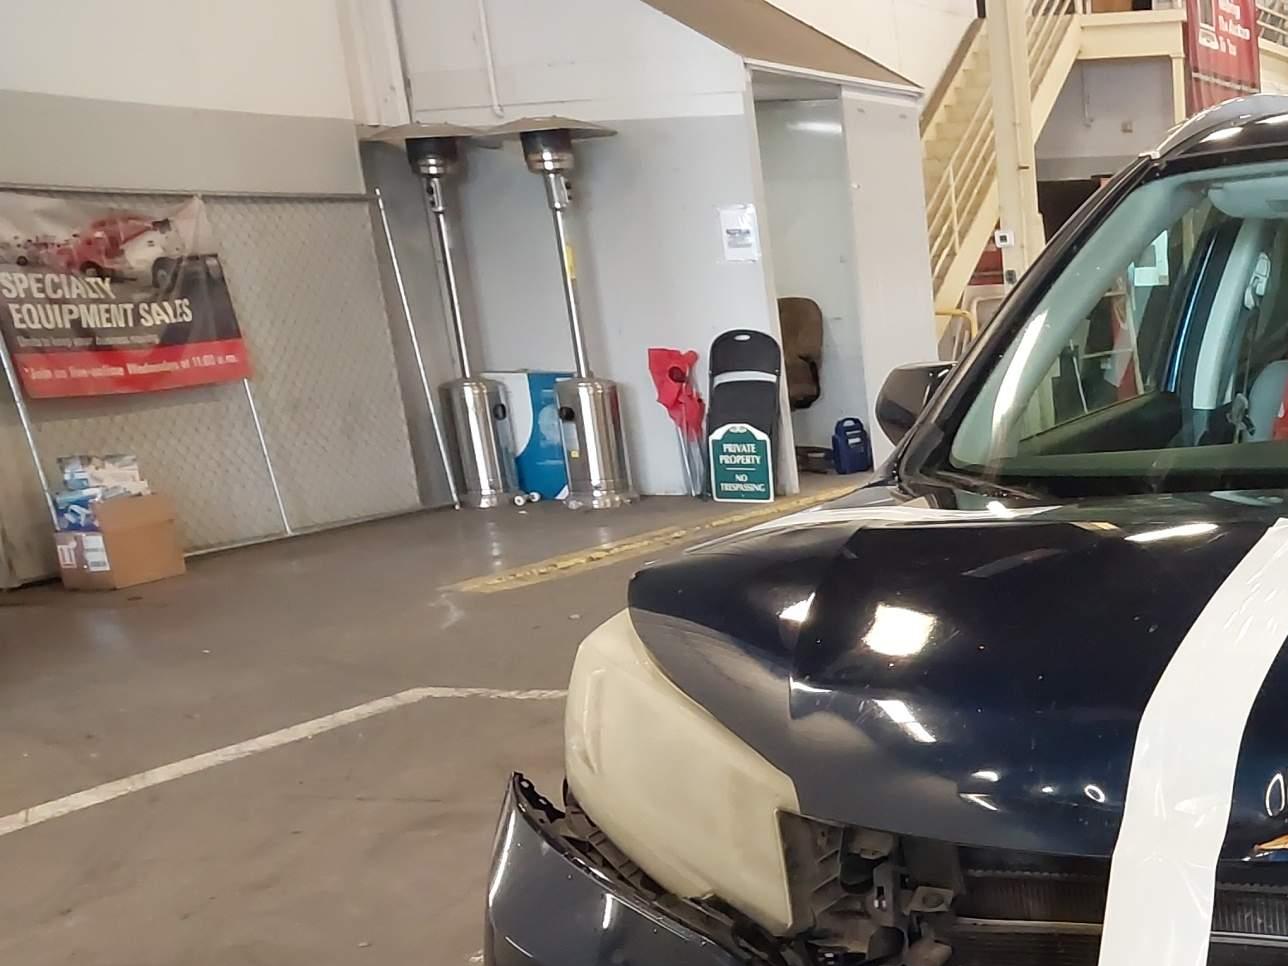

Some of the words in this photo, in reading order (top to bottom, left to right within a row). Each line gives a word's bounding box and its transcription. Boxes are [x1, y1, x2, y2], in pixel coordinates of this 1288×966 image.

[0, 272, 116, 299] SPECIALTY
[8, 303, 135, 329] EQUIPMENT
[138, 298, 193, 327] SALES
[722, 443, 757, 453] PRIVATE
[719, 454, 761, 465] PROPERTY
[735, 473, 749, 482] NO
[720, 483, 766, 492] TRESPASSING
